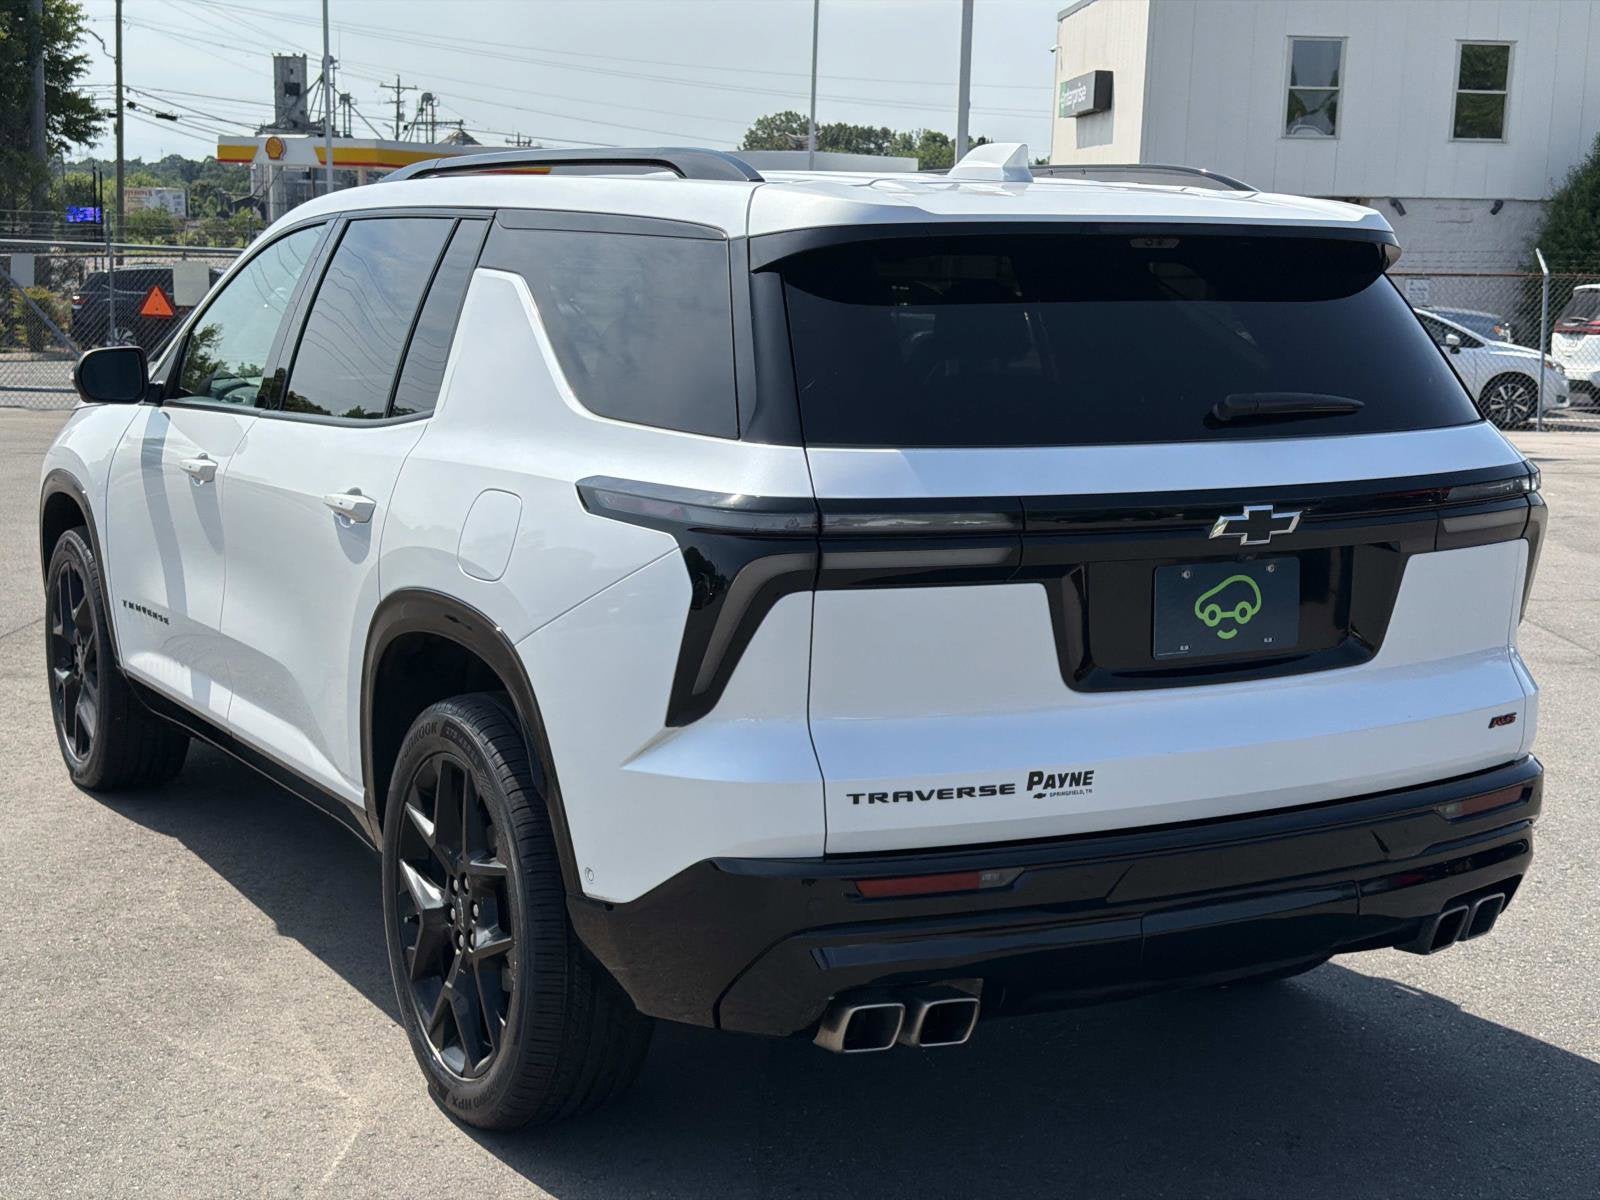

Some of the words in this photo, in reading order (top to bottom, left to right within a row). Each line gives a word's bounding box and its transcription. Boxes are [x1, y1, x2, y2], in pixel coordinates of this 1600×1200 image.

[122, 600, 169, 625] TRAVERSE
[1026, 770, 1095, 791] PAYNE
[846, 783, 1016, 805] TRAVERSE
